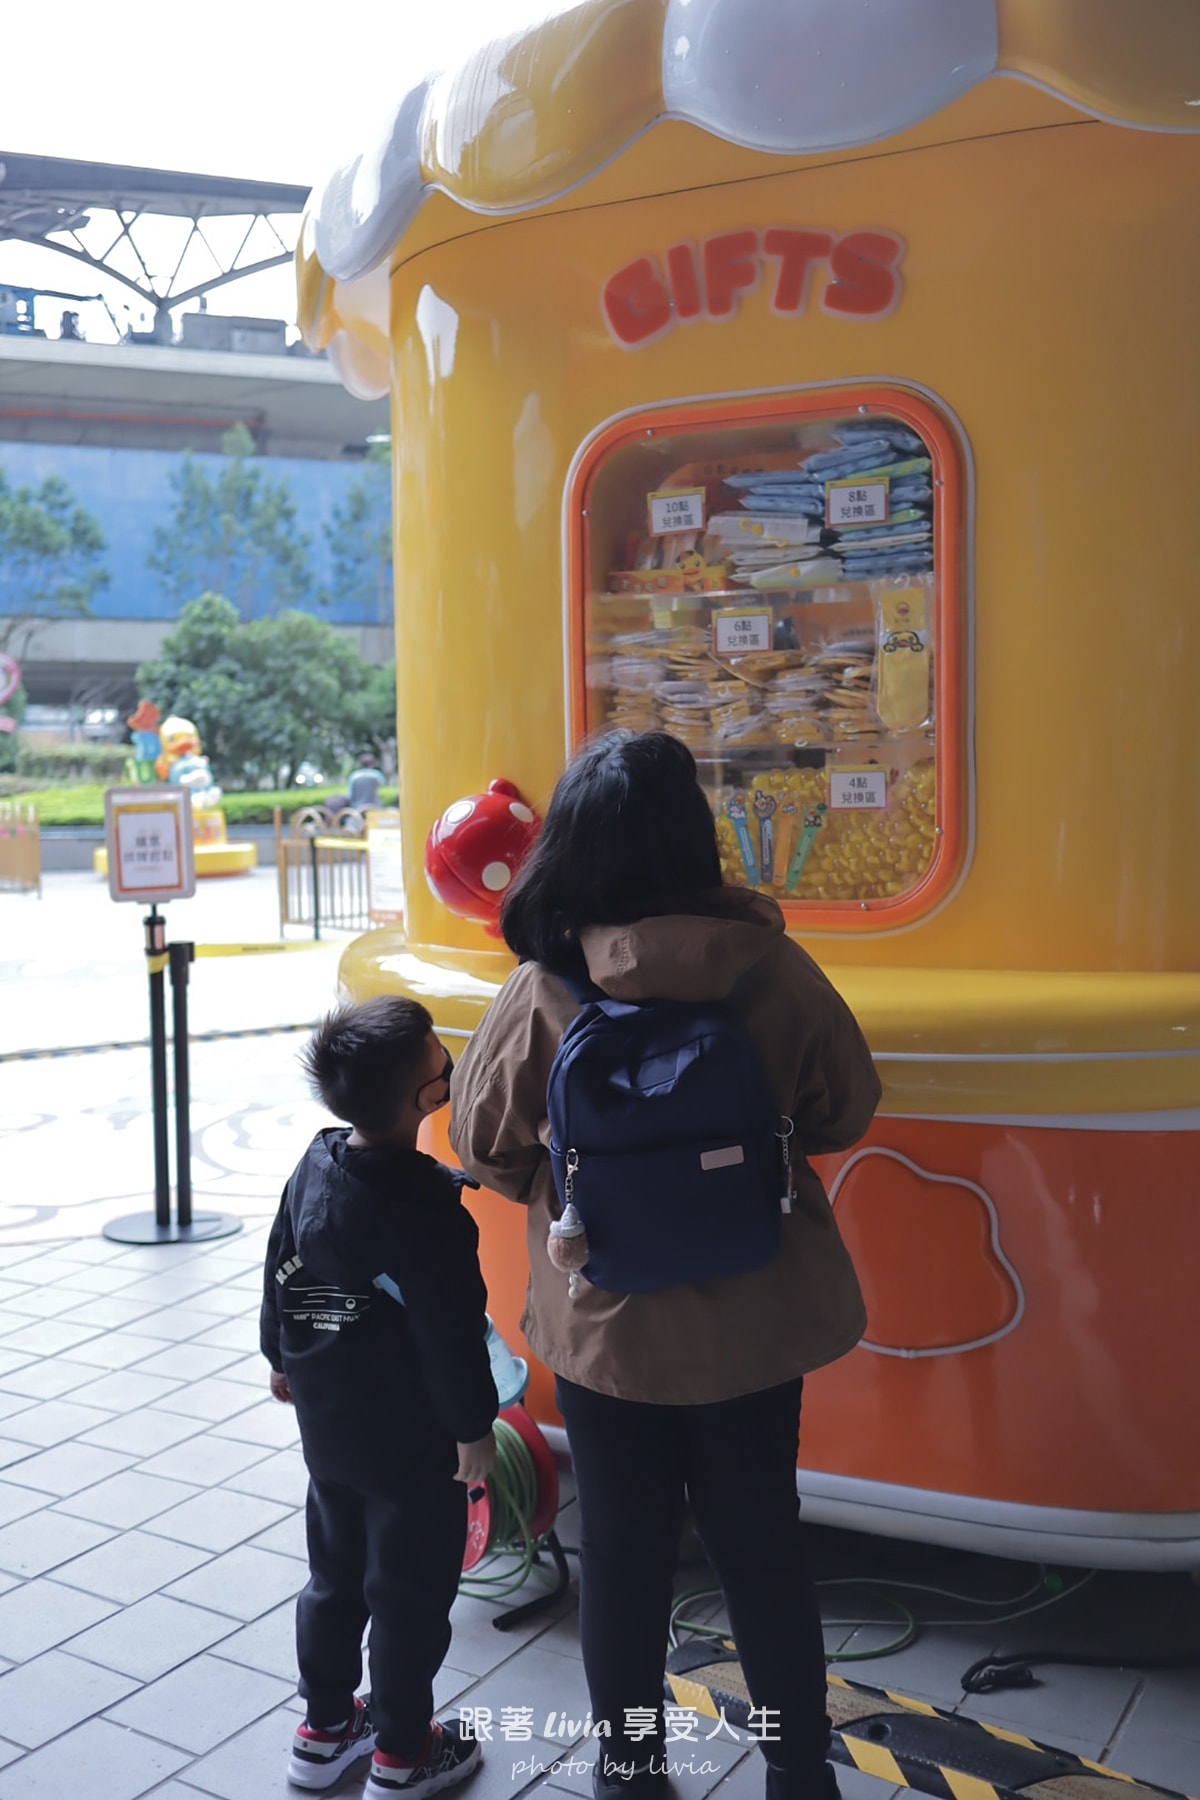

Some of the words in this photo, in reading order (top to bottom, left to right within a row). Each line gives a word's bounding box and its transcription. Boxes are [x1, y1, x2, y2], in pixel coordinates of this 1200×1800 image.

[602, 227, 904, 348] GIFTS
[848, 490, 867, 502] 8點
[665, 501, 689, 513] 10點
[734, 620, 752, 632] 6點
[848, 777, 868, 789] 4點
